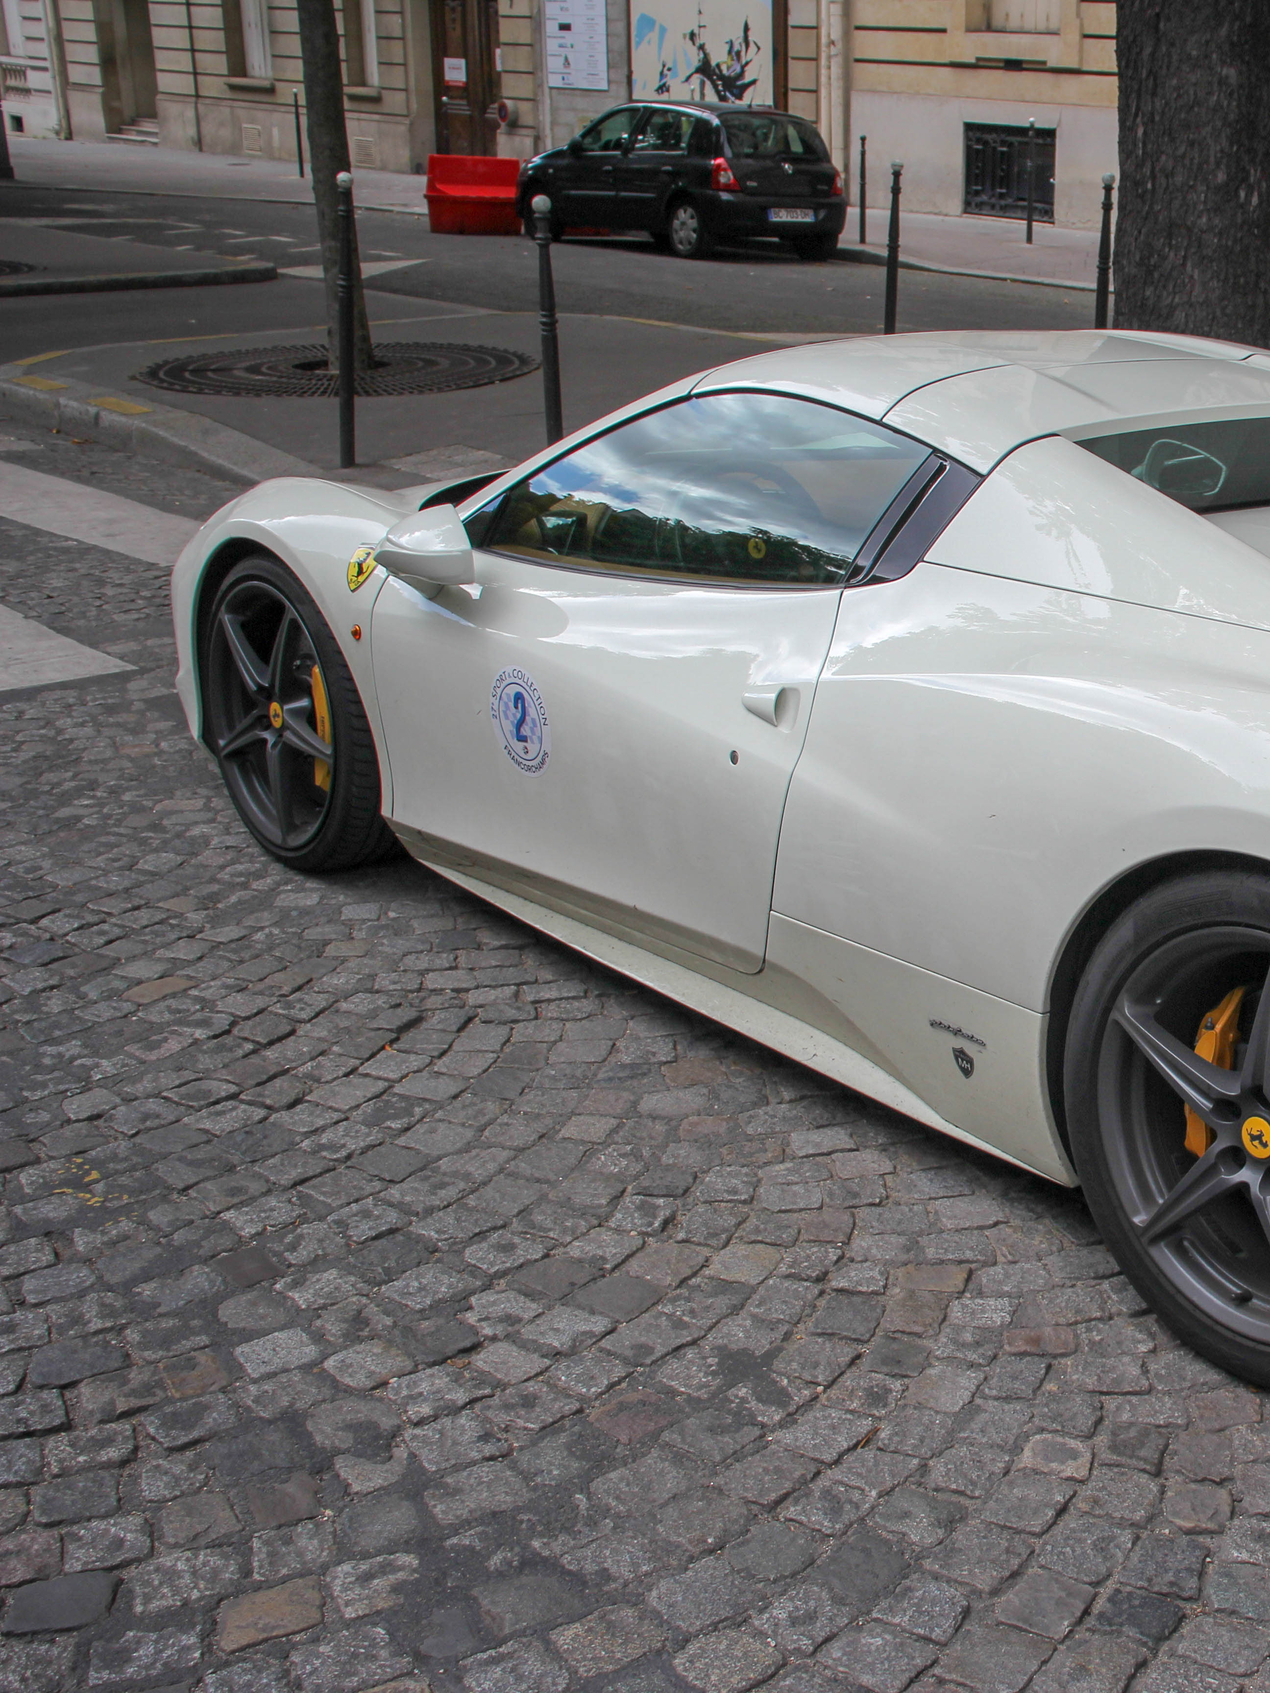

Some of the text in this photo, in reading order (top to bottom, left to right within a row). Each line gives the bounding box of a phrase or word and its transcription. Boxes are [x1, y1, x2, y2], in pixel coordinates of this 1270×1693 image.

[491, 671, 508, 701] SPORT
[512, 668, 548, 726] COLLECTION
[513, 692, 528, 743] 2
[504, 745, 549, 774] FRANCORCHAMPS
